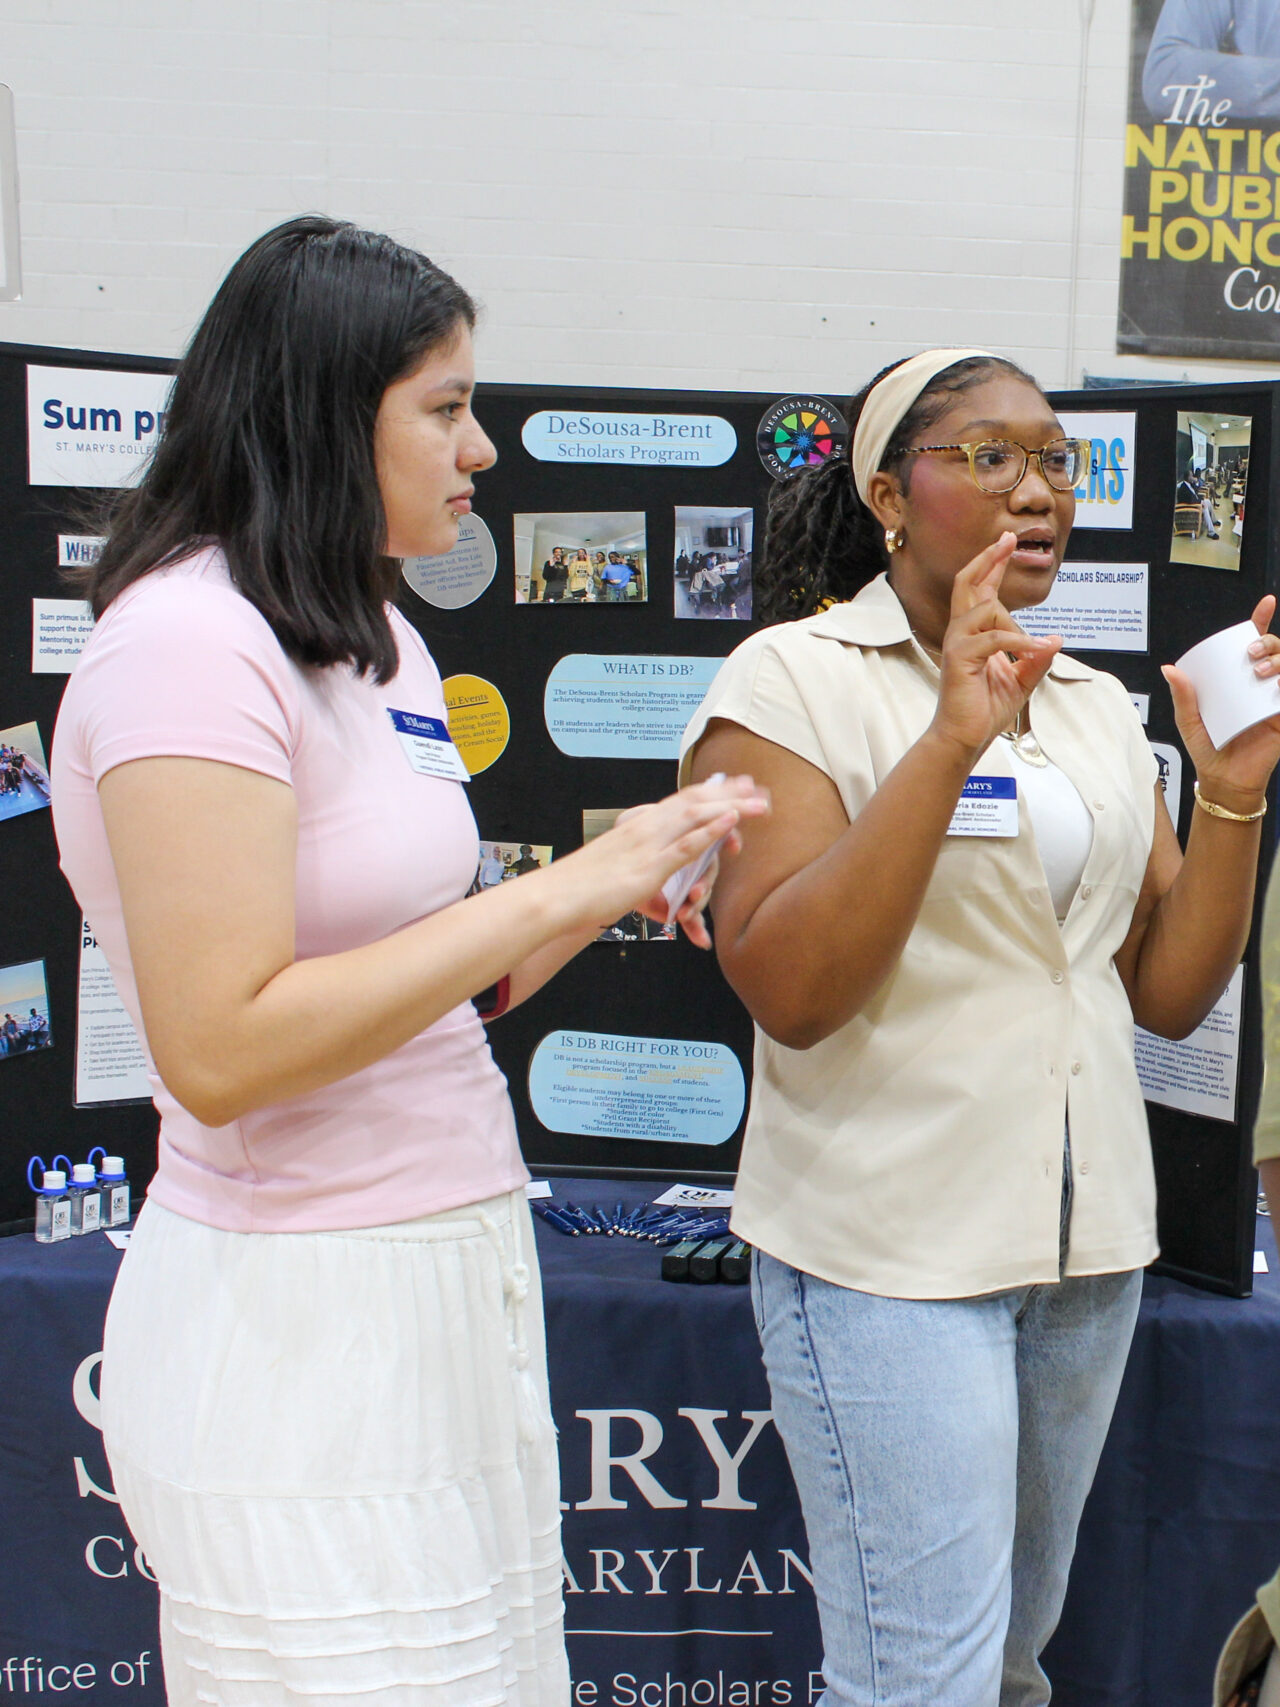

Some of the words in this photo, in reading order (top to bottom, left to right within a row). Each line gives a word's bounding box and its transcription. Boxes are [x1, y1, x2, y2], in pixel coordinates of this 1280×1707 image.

[1161, 74, 1232, 127] The
[43, 398, 122, 432] Sum
[134, 410, 167, 441] pr
[764, 401, 838, 433] DESOUSA-BRENT
[546, 415, 713, 440] DeSousa-Brent
[56, 441, 71, 452] ST.
[76, 442, 116, 454] MARY'S
[119, 444, 155, 455] COLLE
[556, 442, 626, 460] Scholars
[630, 444, 700, 465] Program
[65, 541, 102, 561] WHA
[1095, 571, 1144, 584] SCHOLARSHIP?
[40, 613, 54, 621] Sum
[56, 614, 79, 624] primus
[40, 625, 64, 633] support
[40, 636, 73, 644] Mentoring
[40, 647, 63, 656] college
[603, 662, 649, 675] WHAT
[652, 664, 665, 675] IS
[669, 664, 695, 676] DB?
[458, 694, 489, 704] Events
[554, 688, 567, 696] The
[568, 689, 619, 697] DeSousa-Brent
[649, 691, 678, 699] Program
[552, 696, 585, 704] achieving
[642, 698, 679, 706] historically
[622, 704, 646, 712] college
[646, 705, 680, 713] campuses.
[565, 719, 593, 727] students
[606, 720, 630, 728] leaders
[561, 1035, 574, 1047] IS
[577, 1036, 597, 1049] DB
[600, 1039, 648, 1054] RIGHT
[650, 1043, 679, 1057] FOR
[682, 1045, 719, 1059] YOU?
[553, 1053, 565, 1061] DB
[589, 1058, 627, 1067] scholarship
[572, 1063, 601, 1071] program
[560, 1407, 774, 1511] RY
[0, 1656, 97, 1693] ffice
[110, 1650, 151, 1686] of
[611, 1669, 793, 1707] Scholars
